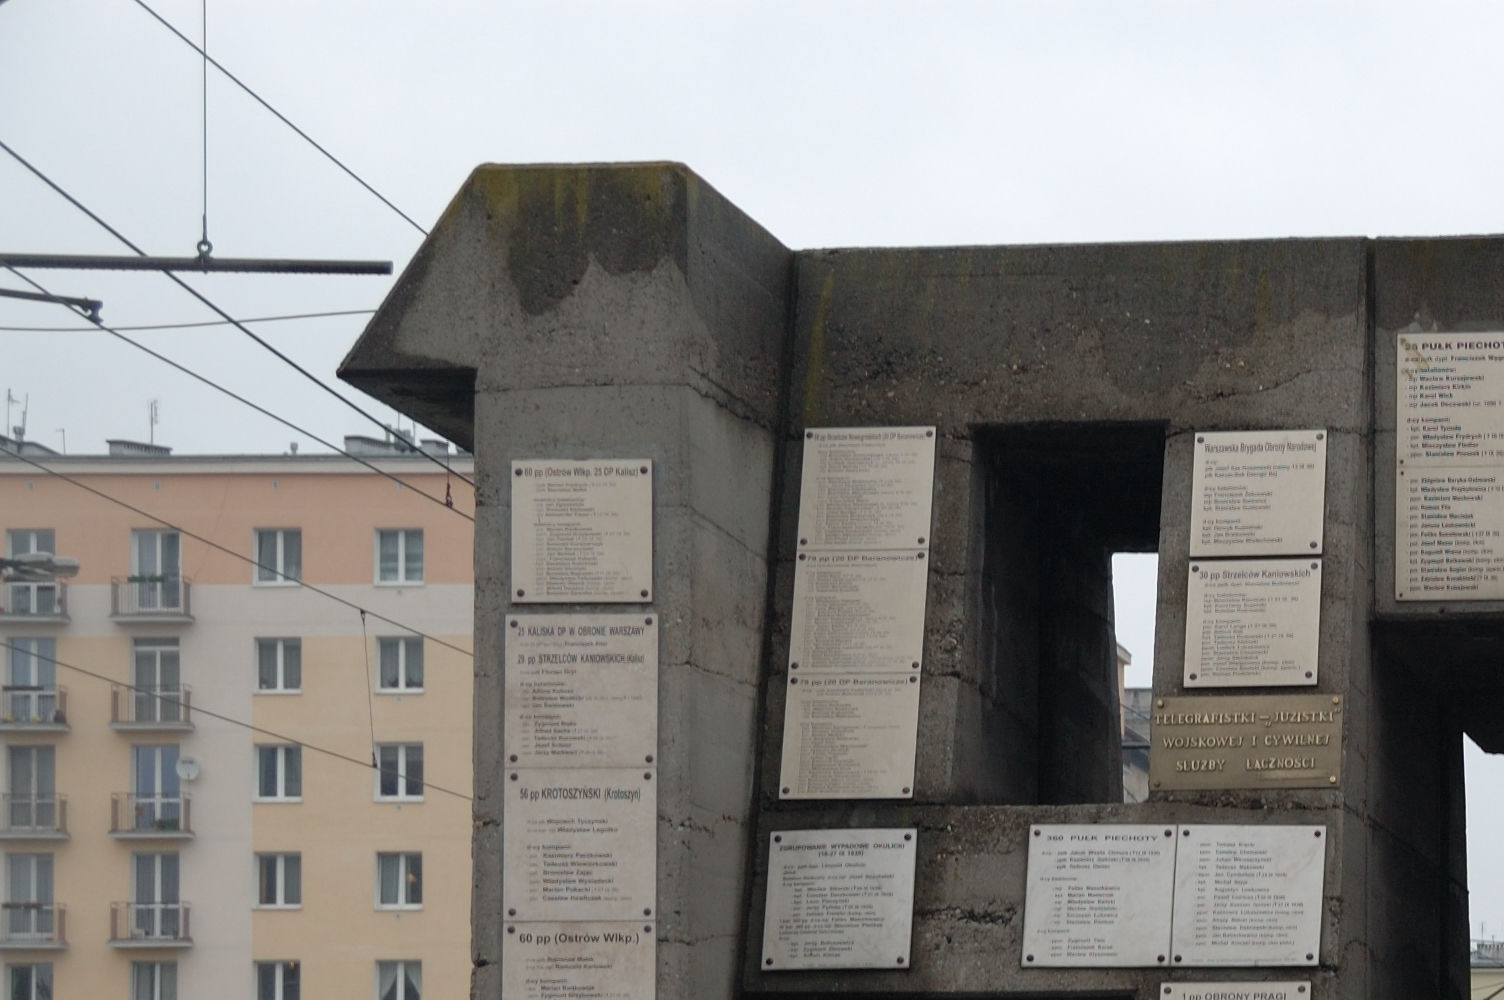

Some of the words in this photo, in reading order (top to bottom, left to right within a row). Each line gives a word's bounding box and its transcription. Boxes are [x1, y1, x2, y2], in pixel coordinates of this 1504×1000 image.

[1422, 342, 1452, 350] PUŁK
[527, 627, 555, 637] KALISKA
[569, 627, 575, 636] W
[578, 626, 606, 636] OBRONIE
[609, 626, 644, 637] WARSZAWY
[539, 653, 577, 664] STRZELCÓW
[581, 654, 625, 664] KANIOWSKICH
[1156, 712, 1255, 725] TELEGRAFISTKI
[1162, 736, 1244, 749] WOJSKOWEJ
[1251, 735, 1258, 747] I
[1264, 734, 1330, 746] CYWILNEJ
[530, 791, 539, 802] pp
[542, 787, 601, 800] KROTOSZYŃSKI
[604, 788, 641, 801] (Krotoszyn)
[519, 933, 532, 944] 60
[536, 935, 551, 945] pp
[555, 933, 600, 945] (Ostrów
[603, 933, 640, 945] Wlkp.)
[1253, 992, 1287, 1000] PRAGI
